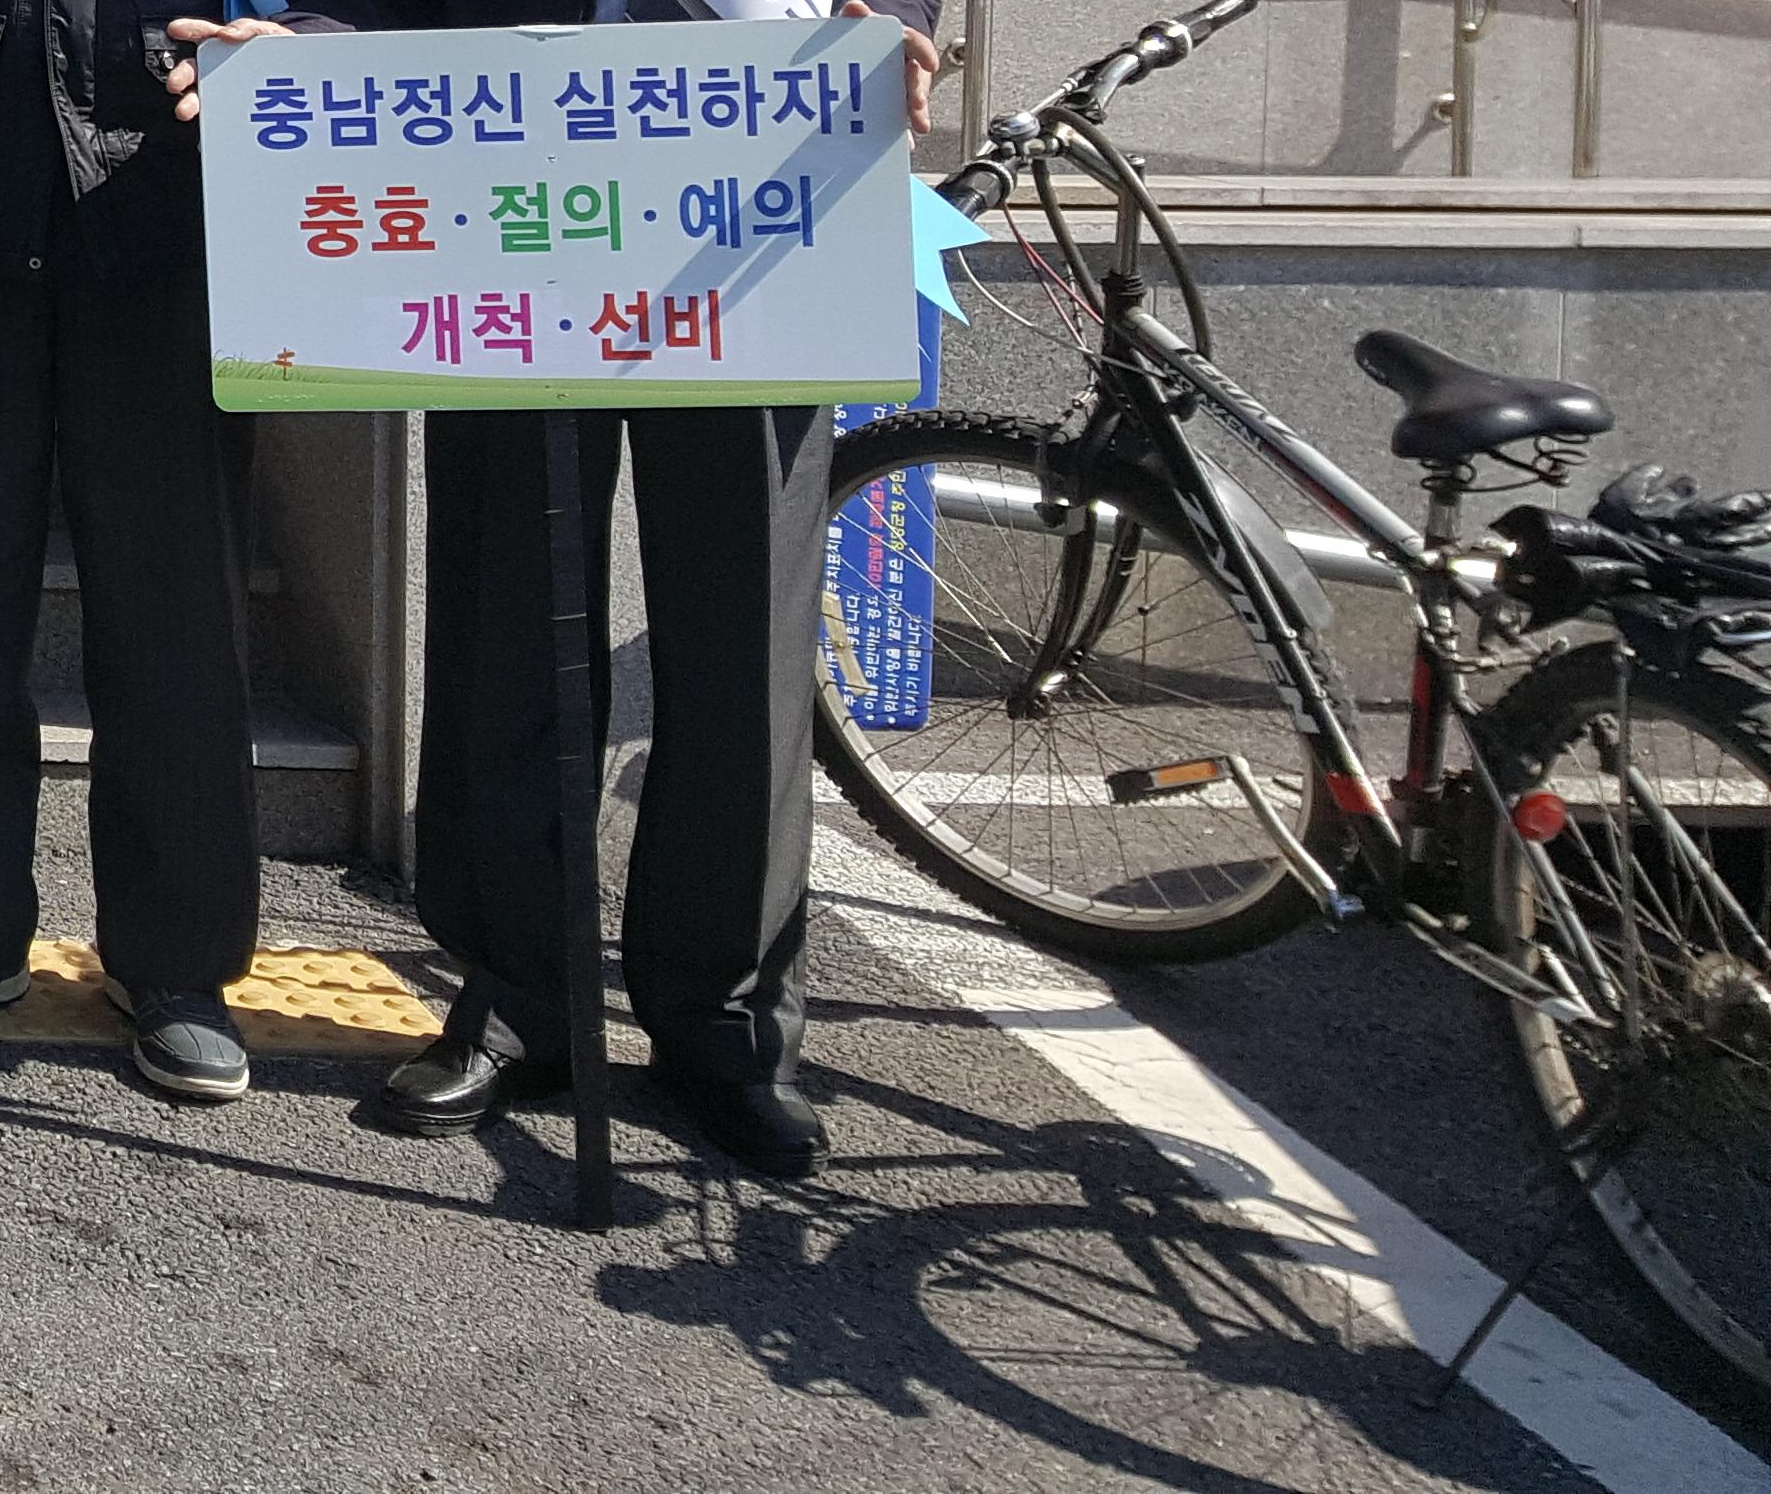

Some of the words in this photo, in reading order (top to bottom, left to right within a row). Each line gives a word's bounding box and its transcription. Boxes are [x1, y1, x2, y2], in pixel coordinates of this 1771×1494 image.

[249, 71, 526, 152] 충남정신
[555, 62, 865, 141] 실천하자!
[299, 185, 436, 259] 충효
[489, 179, 622, 254] 절의
[678, 173, 814, 250] 예의
[401, 292, 535, 365] 개척
[589, 289, 723, 363] 선비
